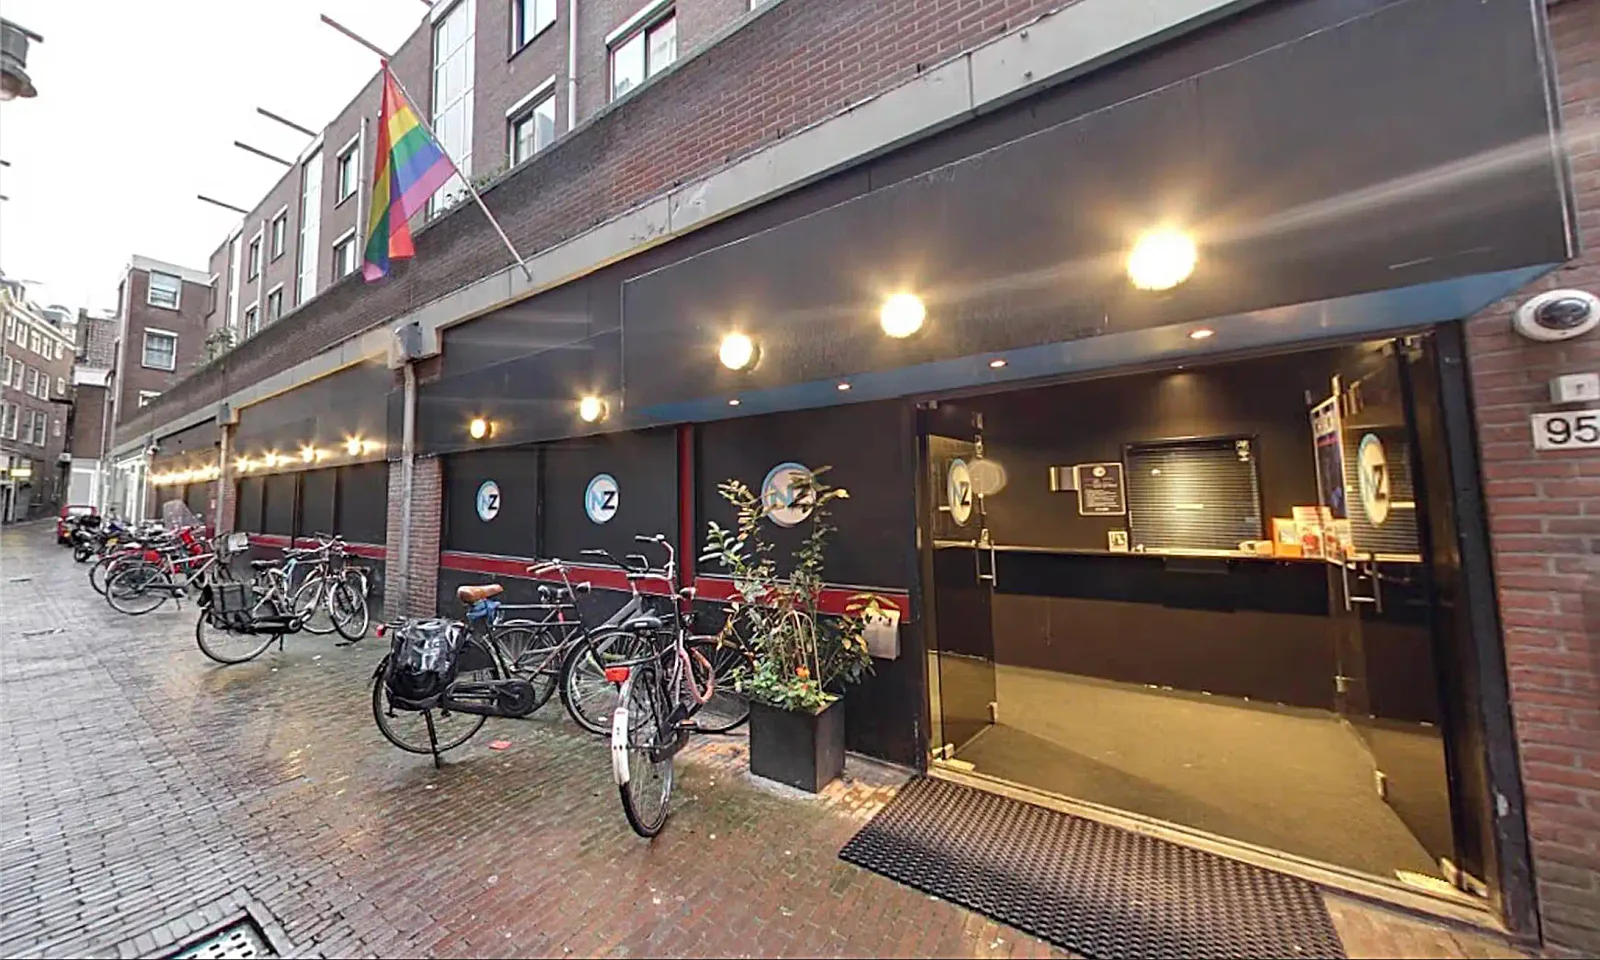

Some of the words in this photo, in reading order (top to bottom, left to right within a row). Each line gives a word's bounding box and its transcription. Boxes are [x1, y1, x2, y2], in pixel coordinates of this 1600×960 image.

[1547, 416, 1598, 444] 95
[952, 481, 970, 507] NZ
[1363, 464, 1386, 501] NZ
[481, 494, 498, 510] NZ
[591, 490, 616, 510] NZ
